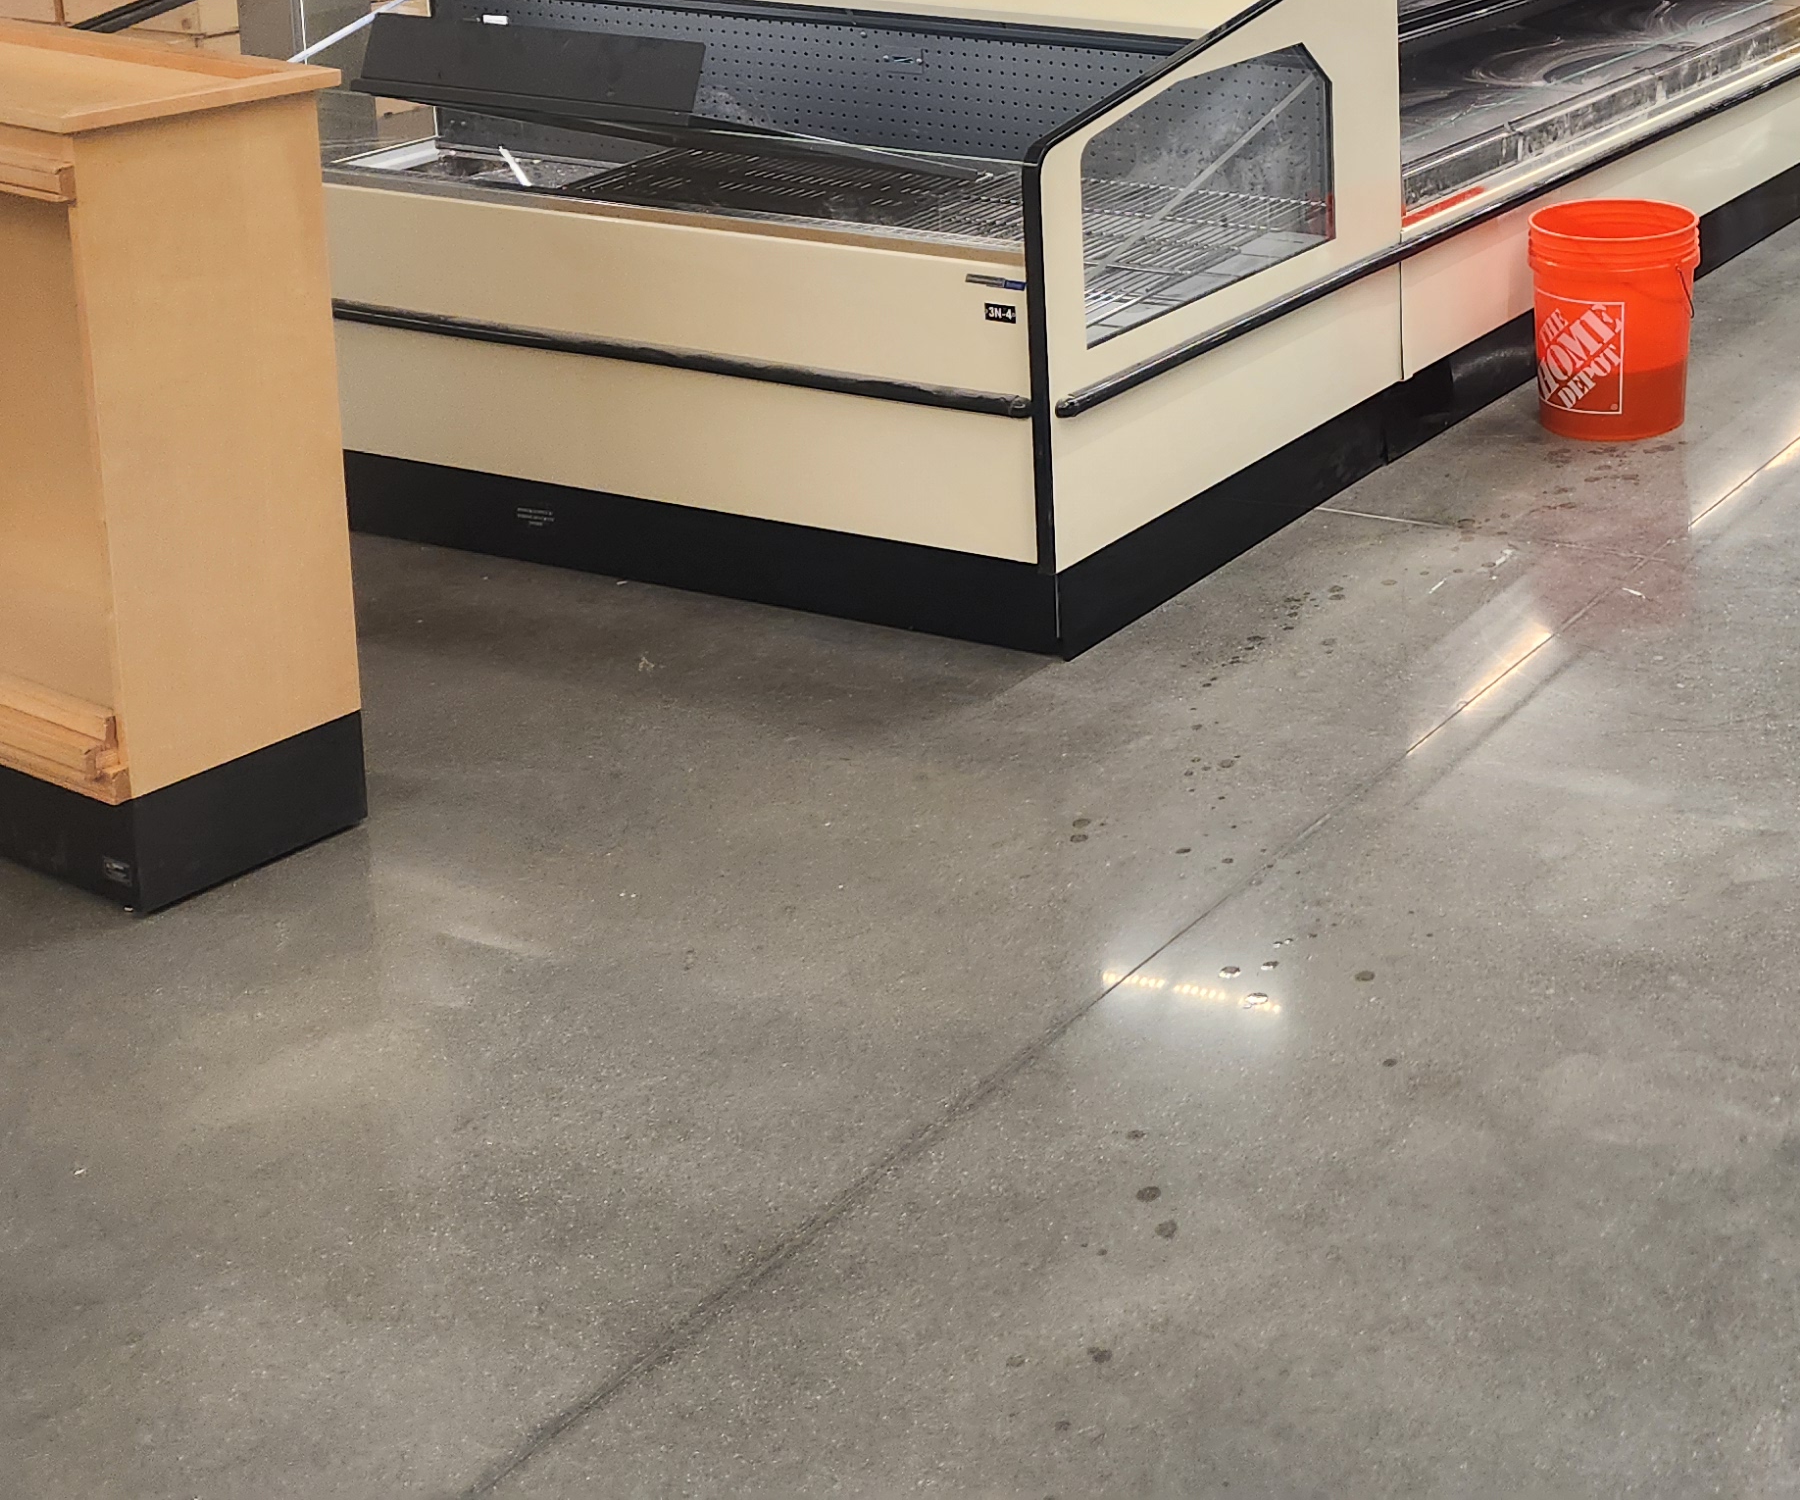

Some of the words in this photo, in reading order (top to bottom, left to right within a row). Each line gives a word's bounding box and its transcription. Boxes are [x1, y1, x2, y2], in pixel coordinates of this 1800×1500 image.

[1538, 307, 1570, 348] THE
[1538, 302, 1623, 402] HOME
[1557, 343, 1623, 410] DEPOT
